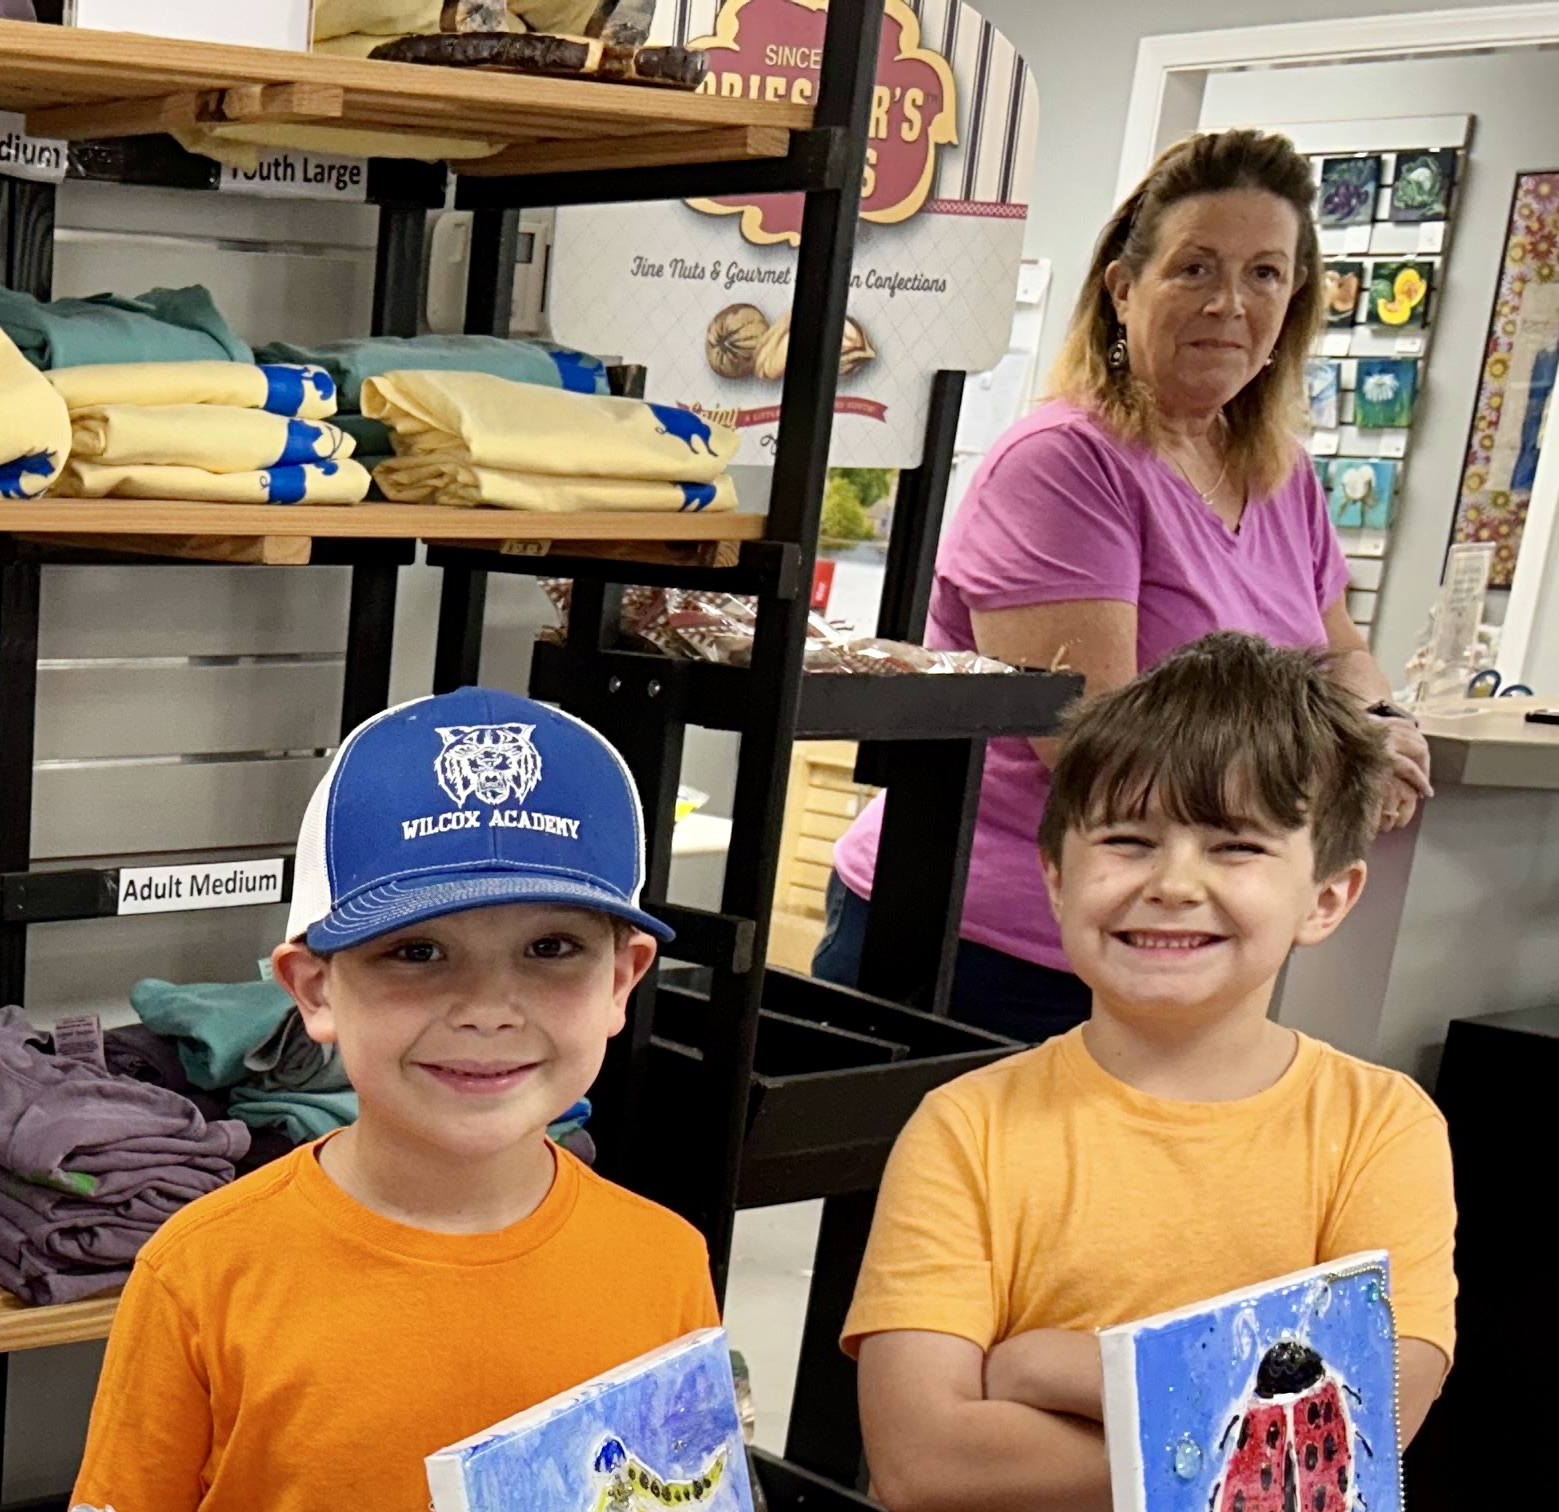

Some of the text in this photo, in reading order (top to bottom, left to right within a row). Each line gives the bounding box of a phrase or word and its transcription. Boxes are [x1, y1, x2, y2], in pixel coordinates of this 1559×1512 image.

[764, 44, 822, 69] SINCE
[302, 157, 361, 190] Large
[631, 256, 664, 277] Fine
[669, 258, 705, 280] Nuts
[710, 261, 721, 280] &
[725, 261, 791, 290] Gourmet
[865, 268, 947, 298] Confections
[401, 809, 581, 840] WILCOX ACADEMY
[123, 870, 278, 903] Adult Medium
